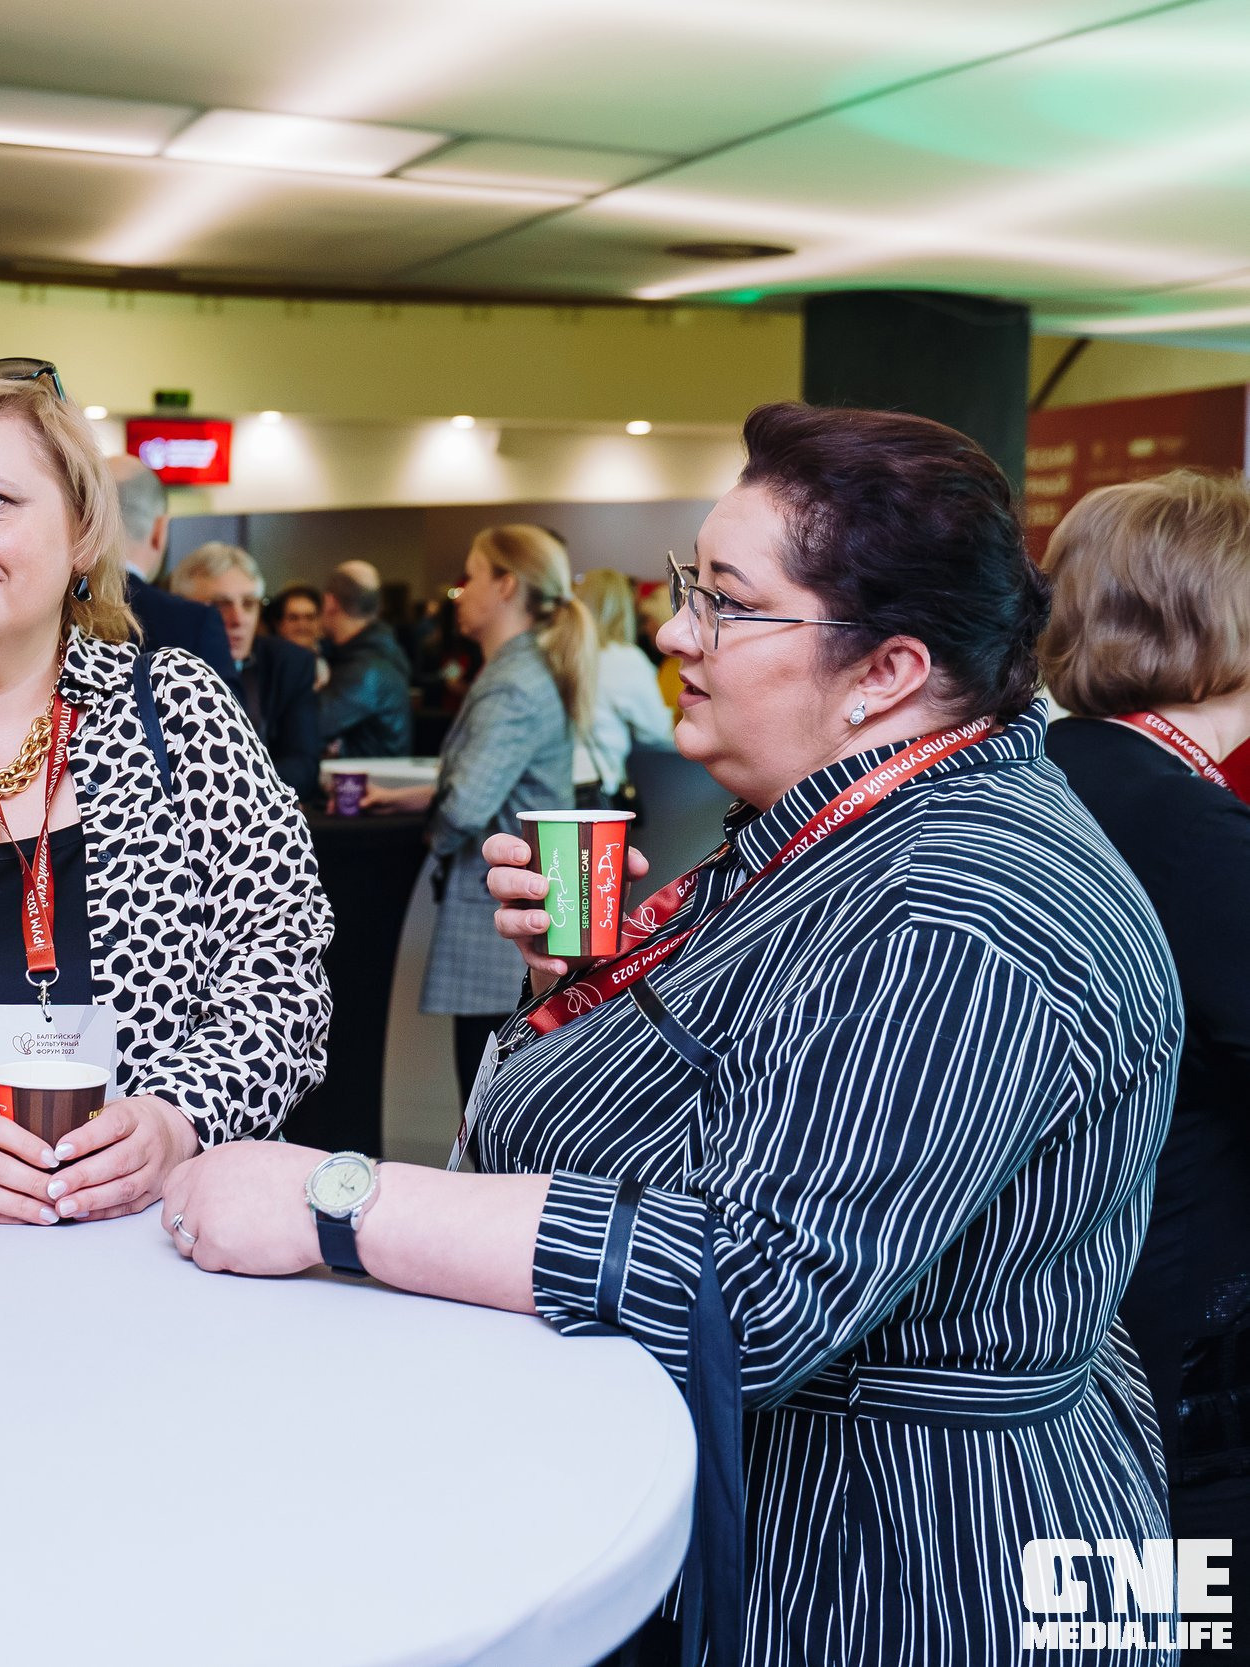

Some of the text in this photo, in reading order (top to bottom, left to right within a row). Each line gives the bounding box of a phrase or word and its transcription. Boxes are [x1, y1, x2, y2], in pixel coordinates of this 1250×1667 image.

[53, 700, 72, 766] ЛТИЙСКИЙ
[1145, 714, 1173, 736] 2023
[863, 731, 962, 796] КУЛЬТУРНЫЙ
[1170, 730, 1208, 767] ФОРУМ
[809, 790, 866, 842] ФОРУМ
[597, 843, 621, 881] Day
[547, 847, 575, 928] Carpe Diem
[581, 848, 590, 929] SERVED WITH CARE
[599, 895, 616, 930] Seize
[611, 963, 640, 984] 2023
[36, 1032, 81, 1040] БАЛТИЙСКИЙ
